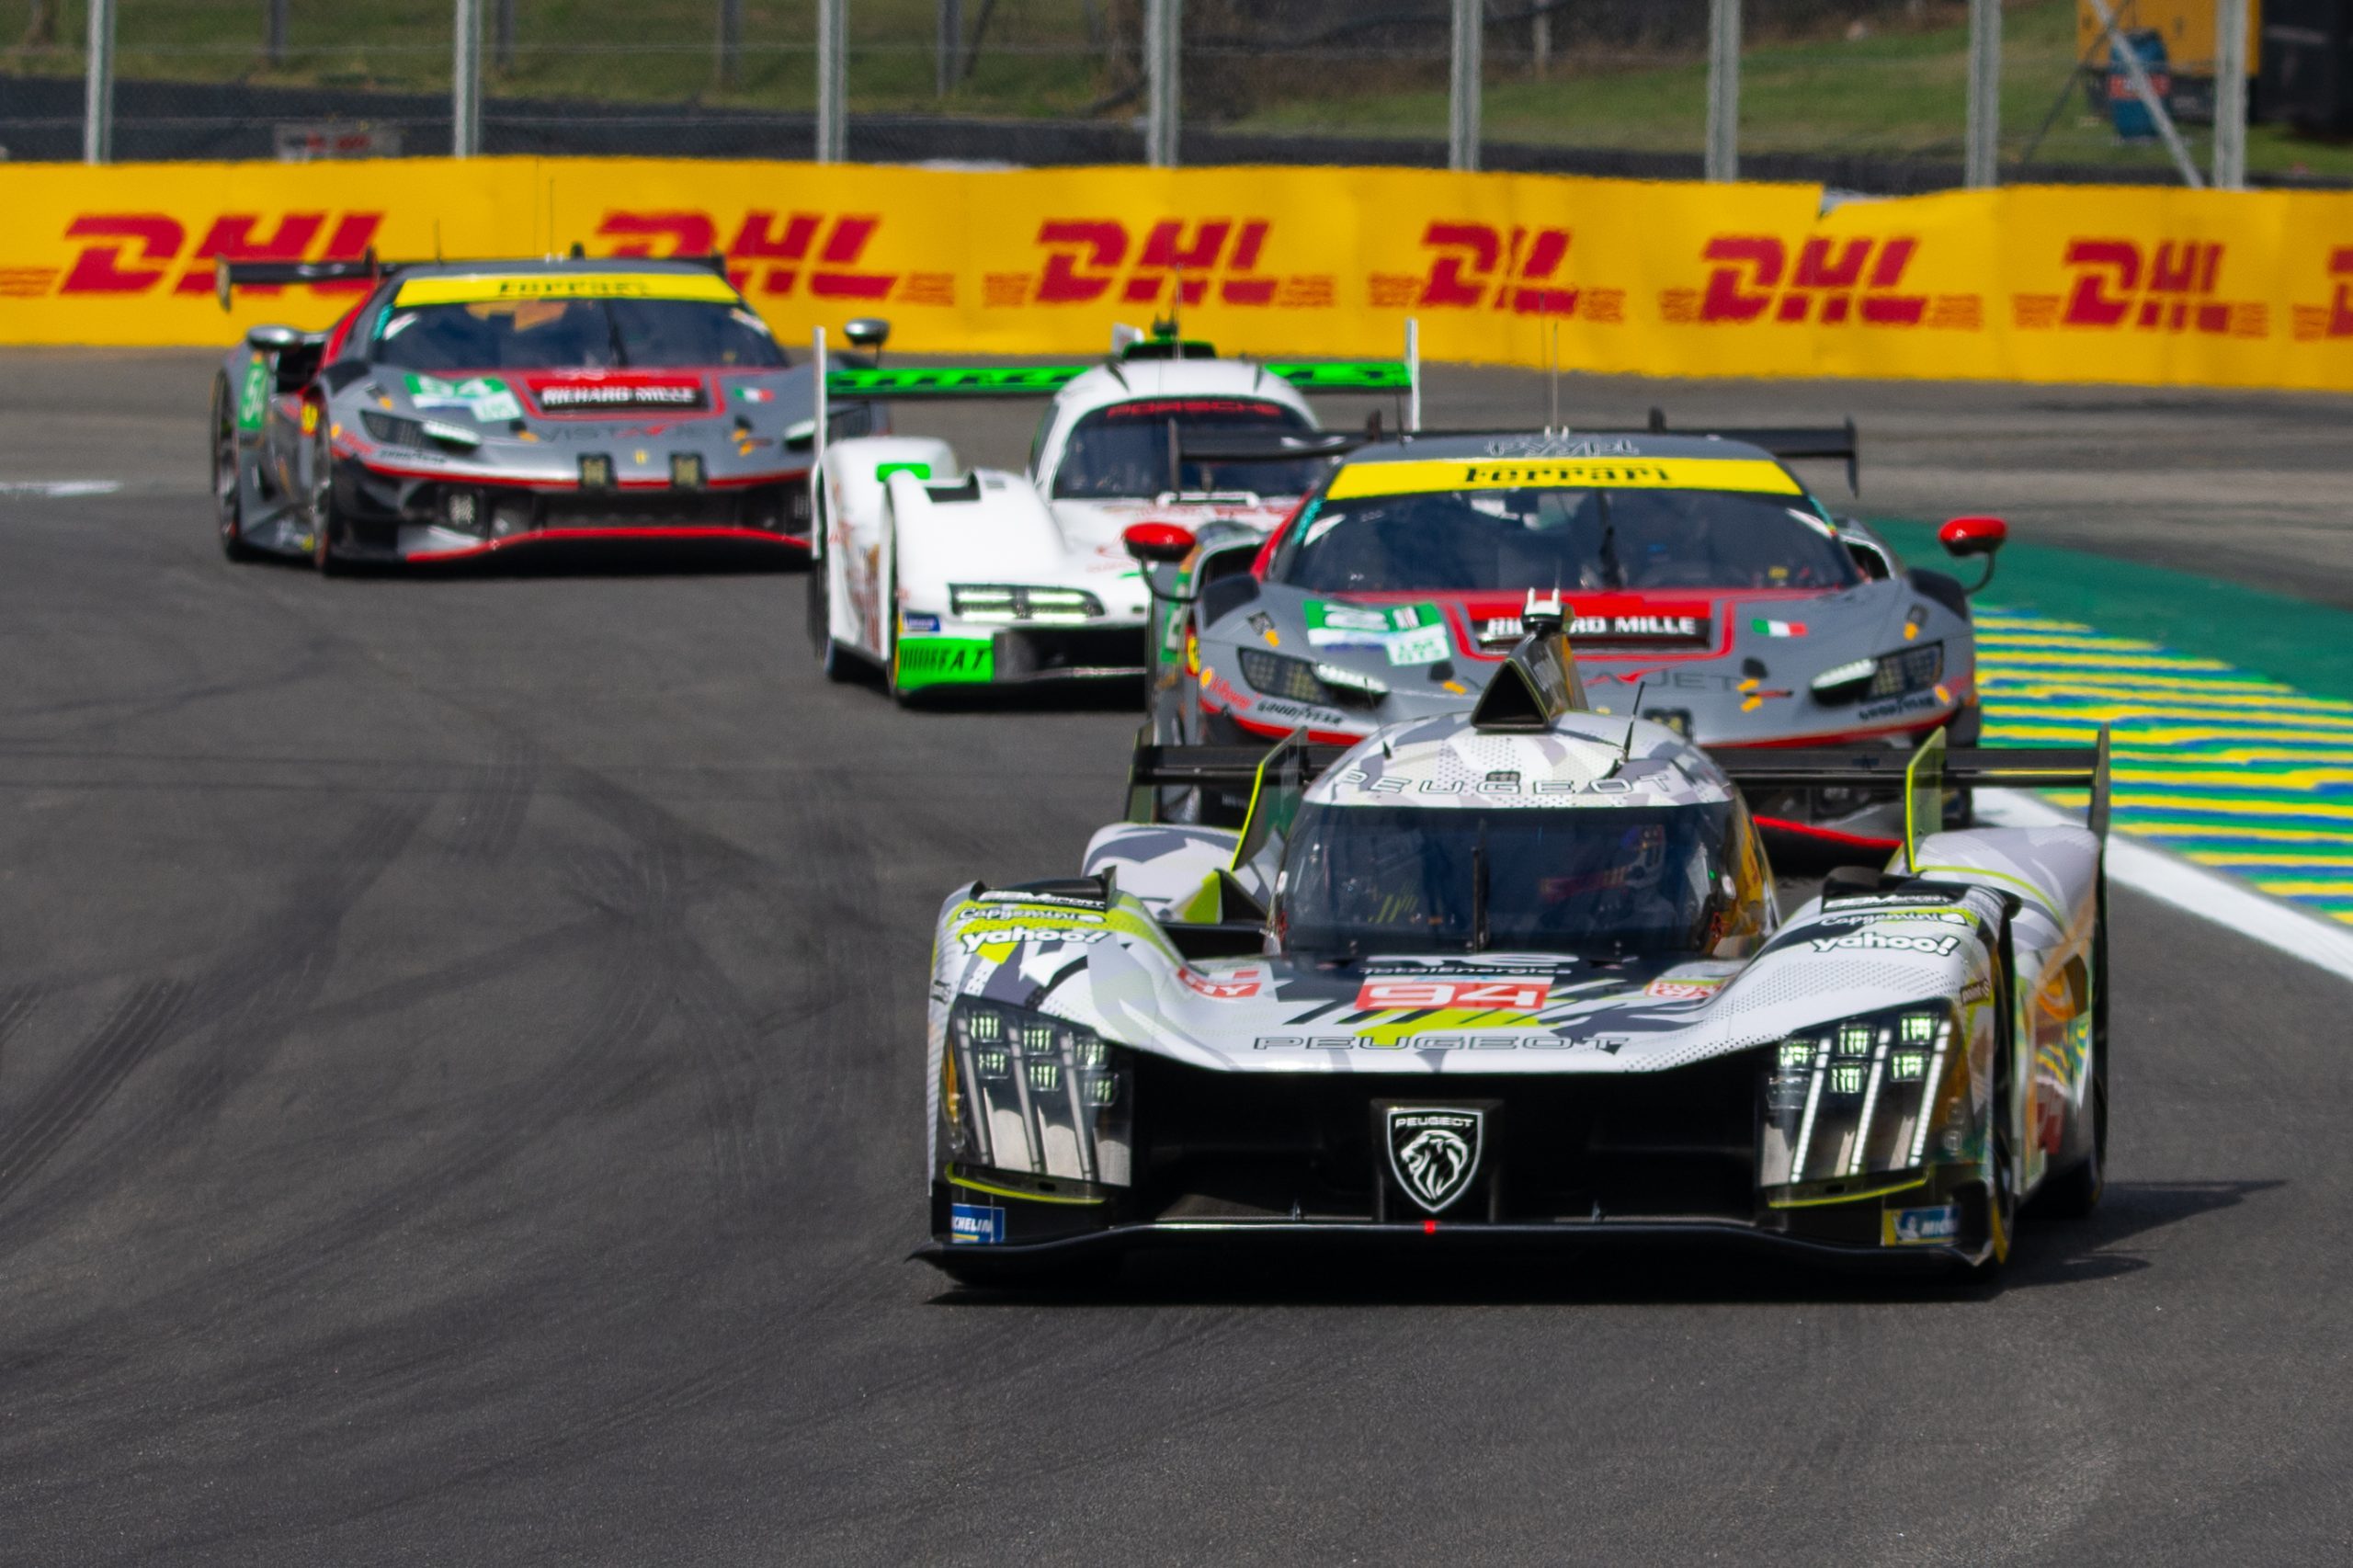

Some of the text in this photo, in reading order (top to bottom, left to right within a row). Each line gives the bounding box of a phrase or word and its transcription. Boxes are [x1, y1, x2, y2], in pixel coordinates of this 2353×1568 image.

[59, 212, 386, 297] DHL
[596, 210, 897, 300] DHL
[1034, 218, 1278, 304] DHL
[1700, 235, 1928, 327] DHL
[2062, 238, 2232, 334] DHL
[542, 386, 697, 404] RICHARD MILLE
[1107, 401, 1279, 418] PORSCHE
[1464, 465, 1670, 483] Ferrari
[1488, 615, 1696, 635] RIRD MILLE
[1337, 768, 1670, 796] PEUGEOT
[960, 907, 1077, 922] Capgemini
[1819, 911, 1939, 926] Capgemini
[963, 925, 1109, 955] yahoo!
[1813, 931, 1961, 957] yahoo!
[1358, 966, 1573, 976] TotalEnergies
[1368, 983, 1539, 1008] 94
[1252, 1036, 1631, 1053] PEUGEOT
[1394, 1115, 1474, 1130] PEUGEOT
